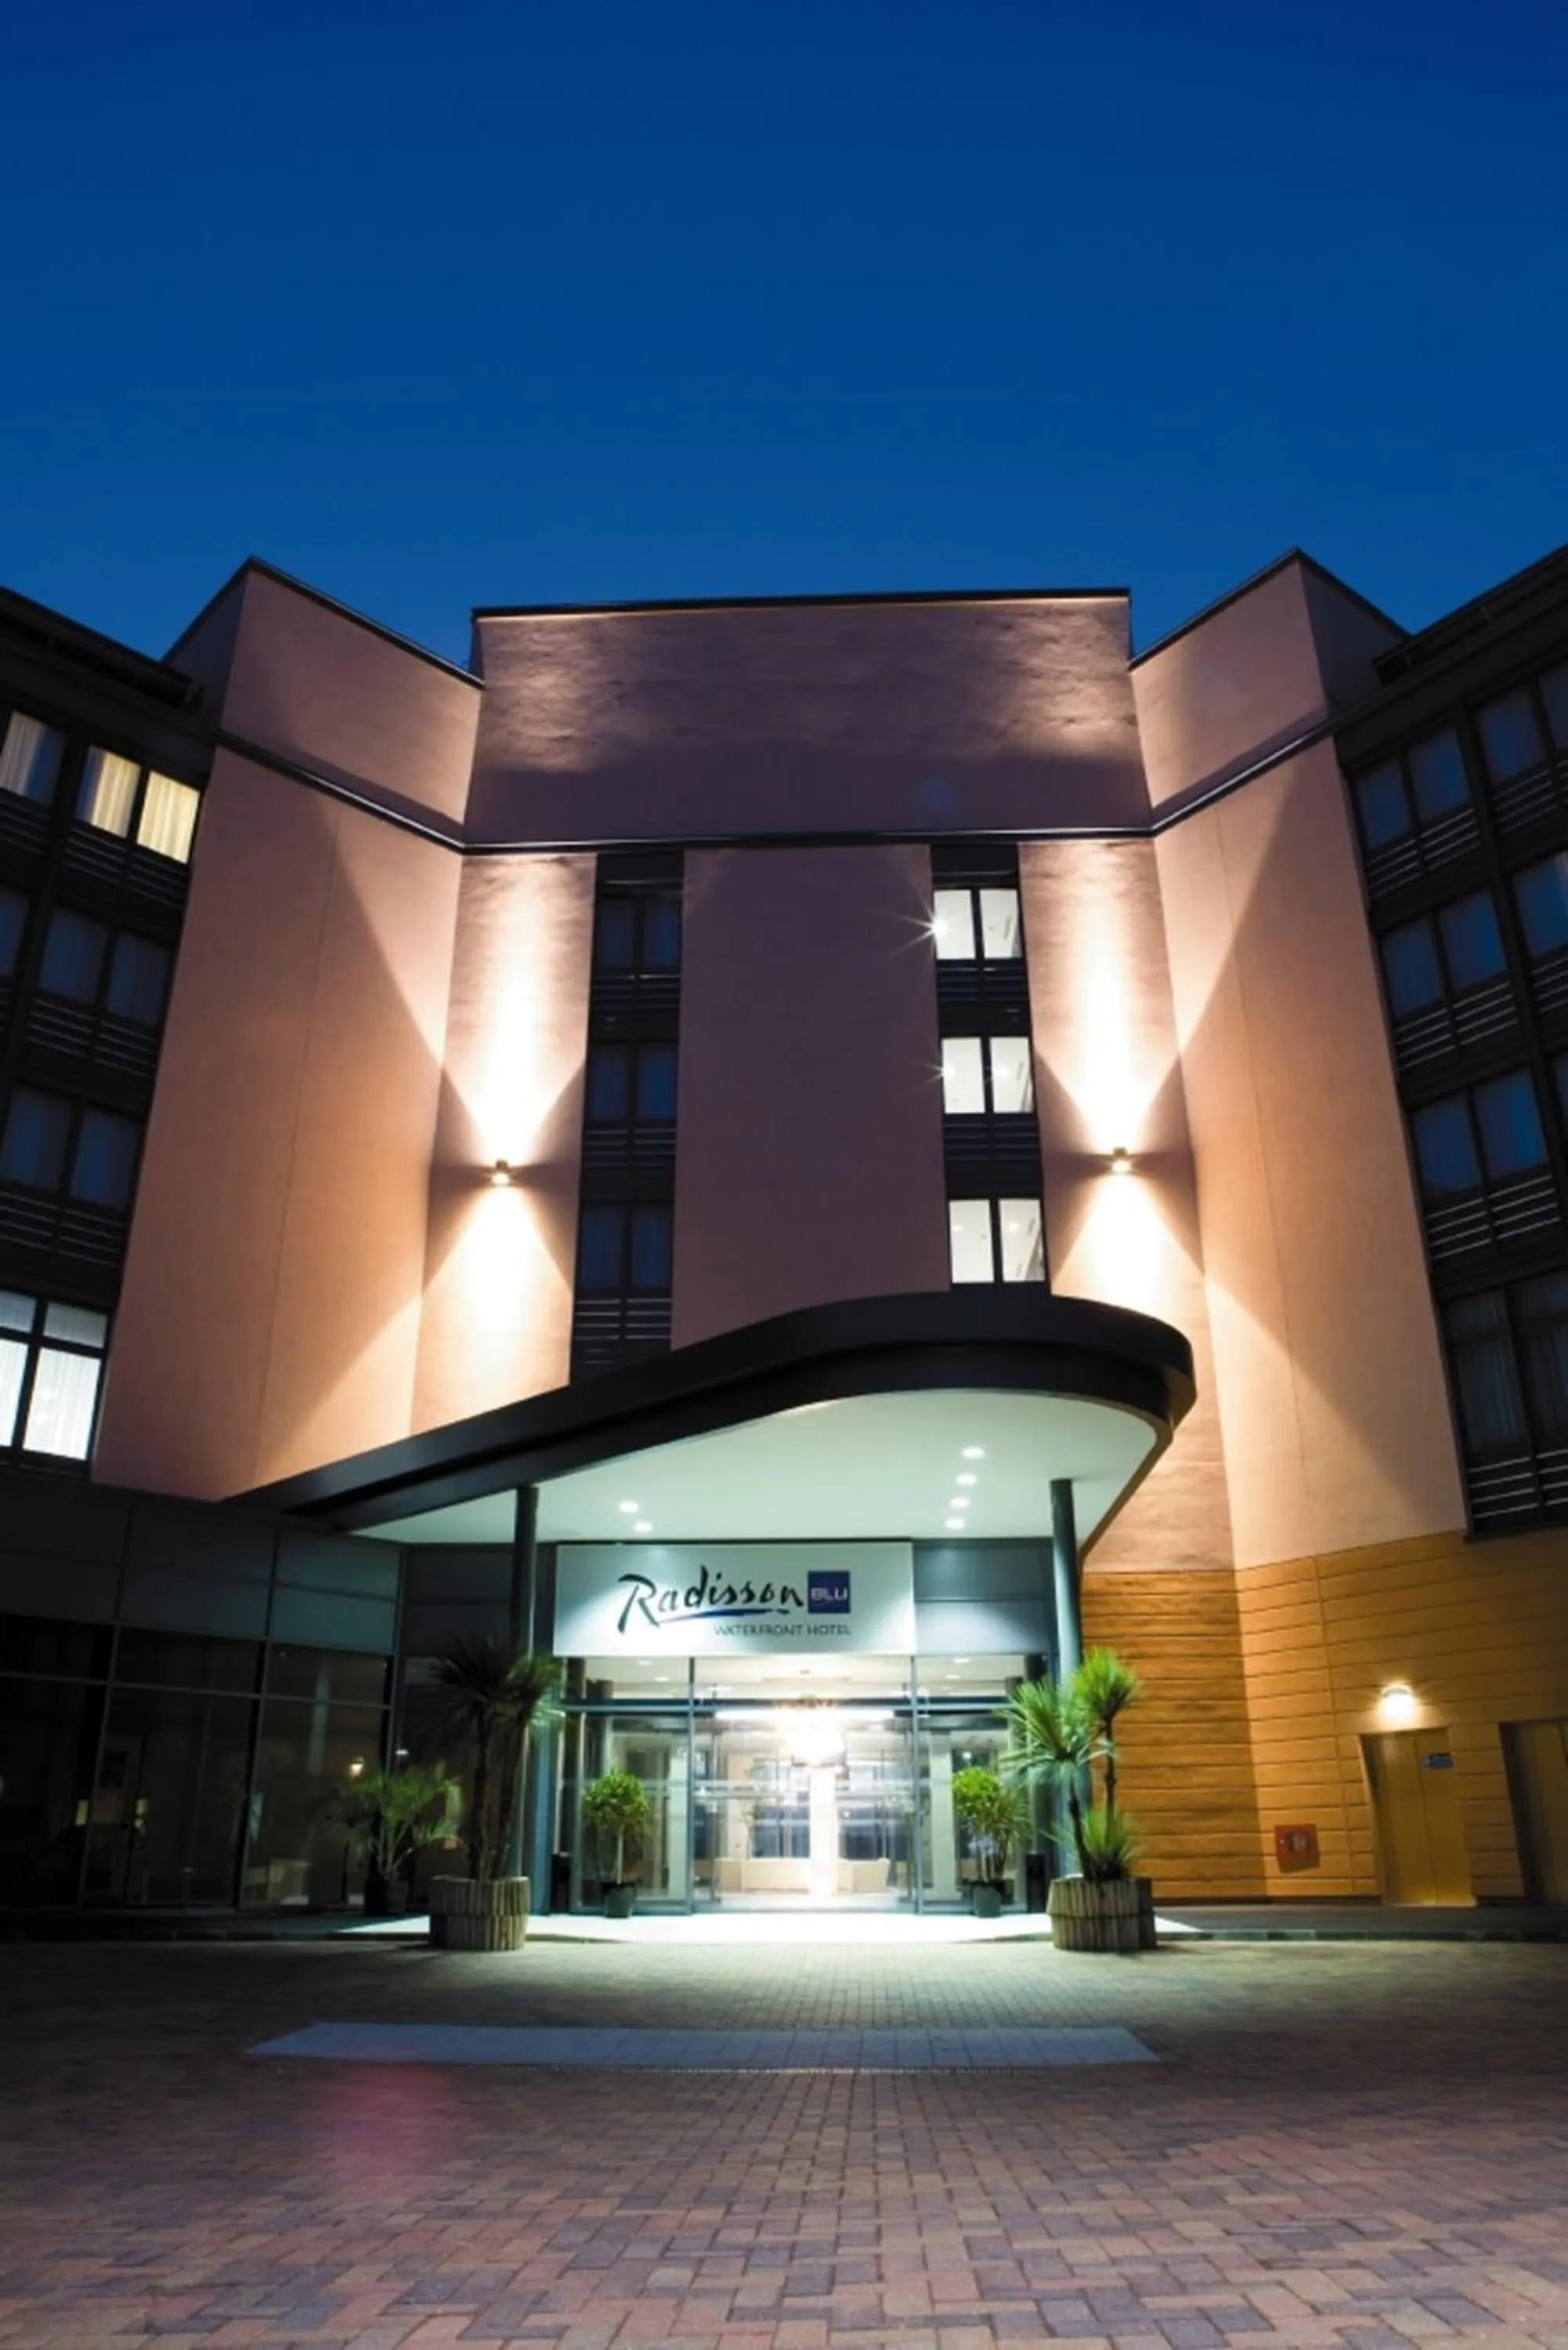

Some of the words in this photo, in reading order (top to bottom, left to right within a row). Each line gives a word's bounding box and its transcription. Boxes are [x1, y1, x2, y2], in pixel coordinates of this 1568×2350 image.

[617, 1565, 804, 1632] Radisson
[810, 1587, 848, 1601] BLU
[714, 1624, 804, 1636] WATERFRONT
[807, 1623, 852, 1636] HOTEL
